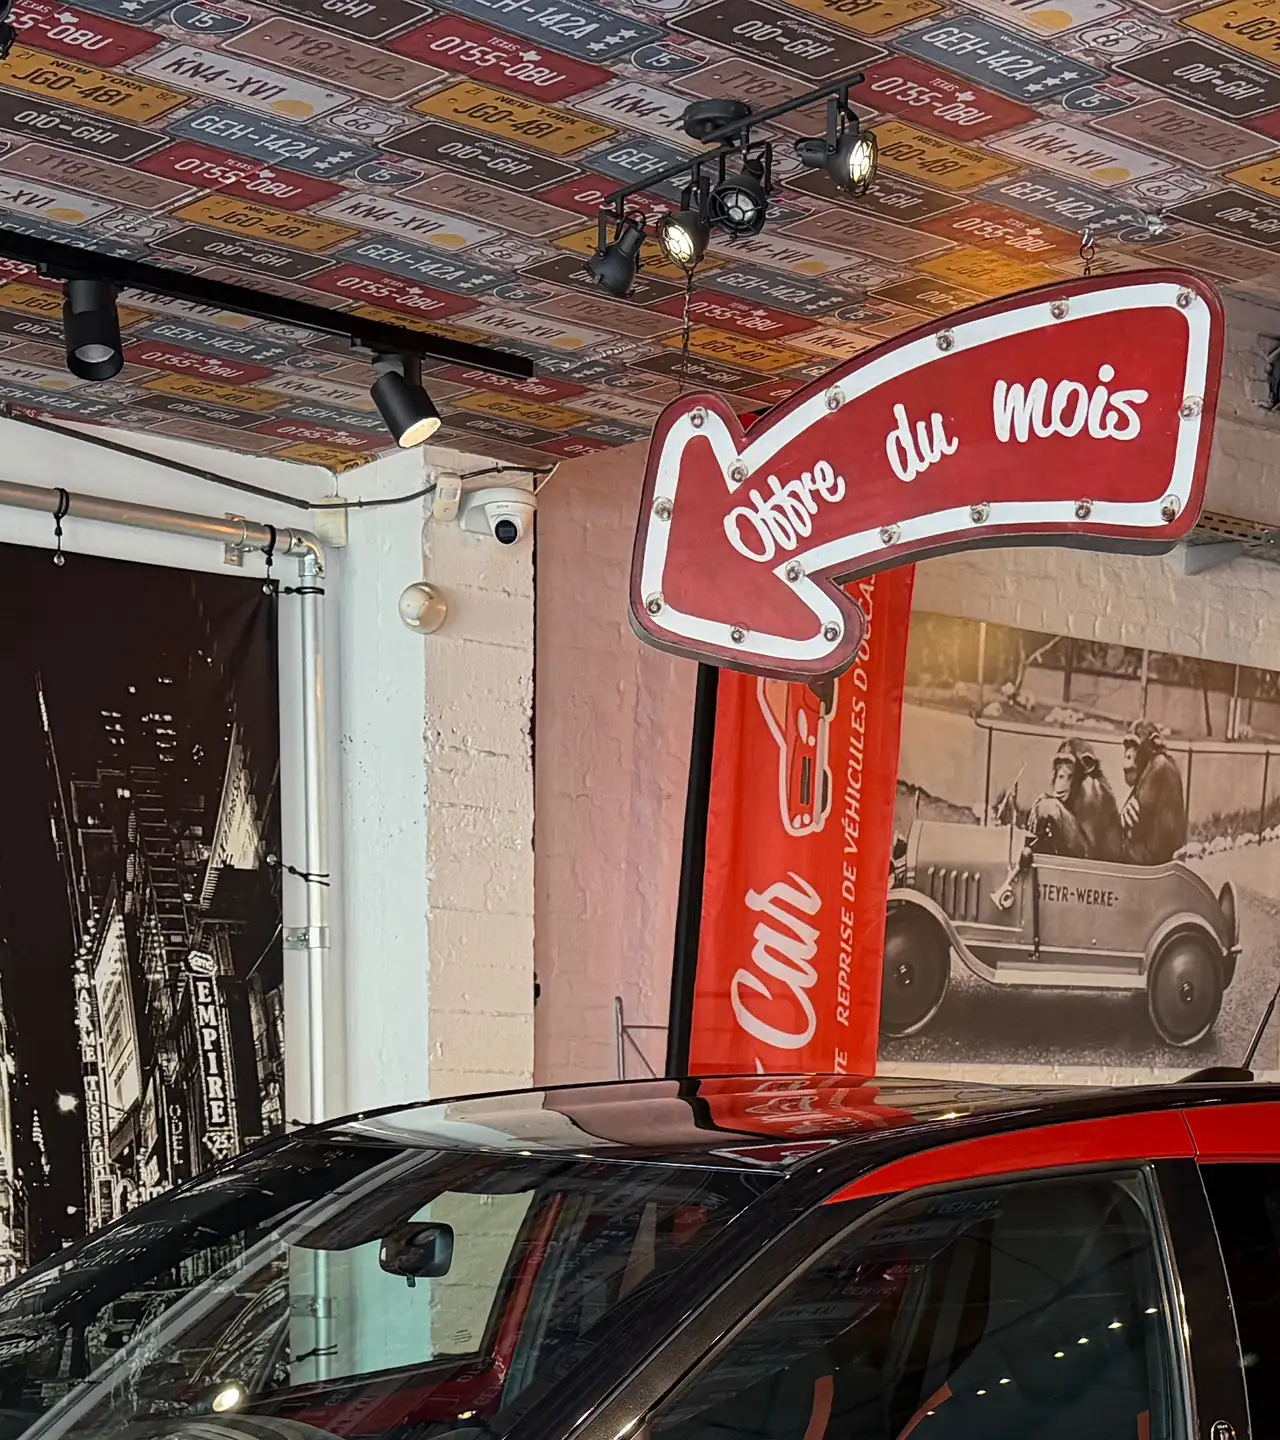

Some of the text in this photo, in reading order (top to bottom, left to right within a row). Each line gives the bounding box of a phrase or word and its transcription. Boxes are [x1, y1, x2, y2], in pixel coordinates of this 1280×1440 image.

[724, 364, 1150, 564] Offre du mois
[841, 696, 867, 854] VÉHICULES
[841, 866, 857, 903] DE
[731, 871, 821, 1049] Car
[837, 907, 855, 1027] REPRISE
[196, 981, 225, 1123] EMPIRE
